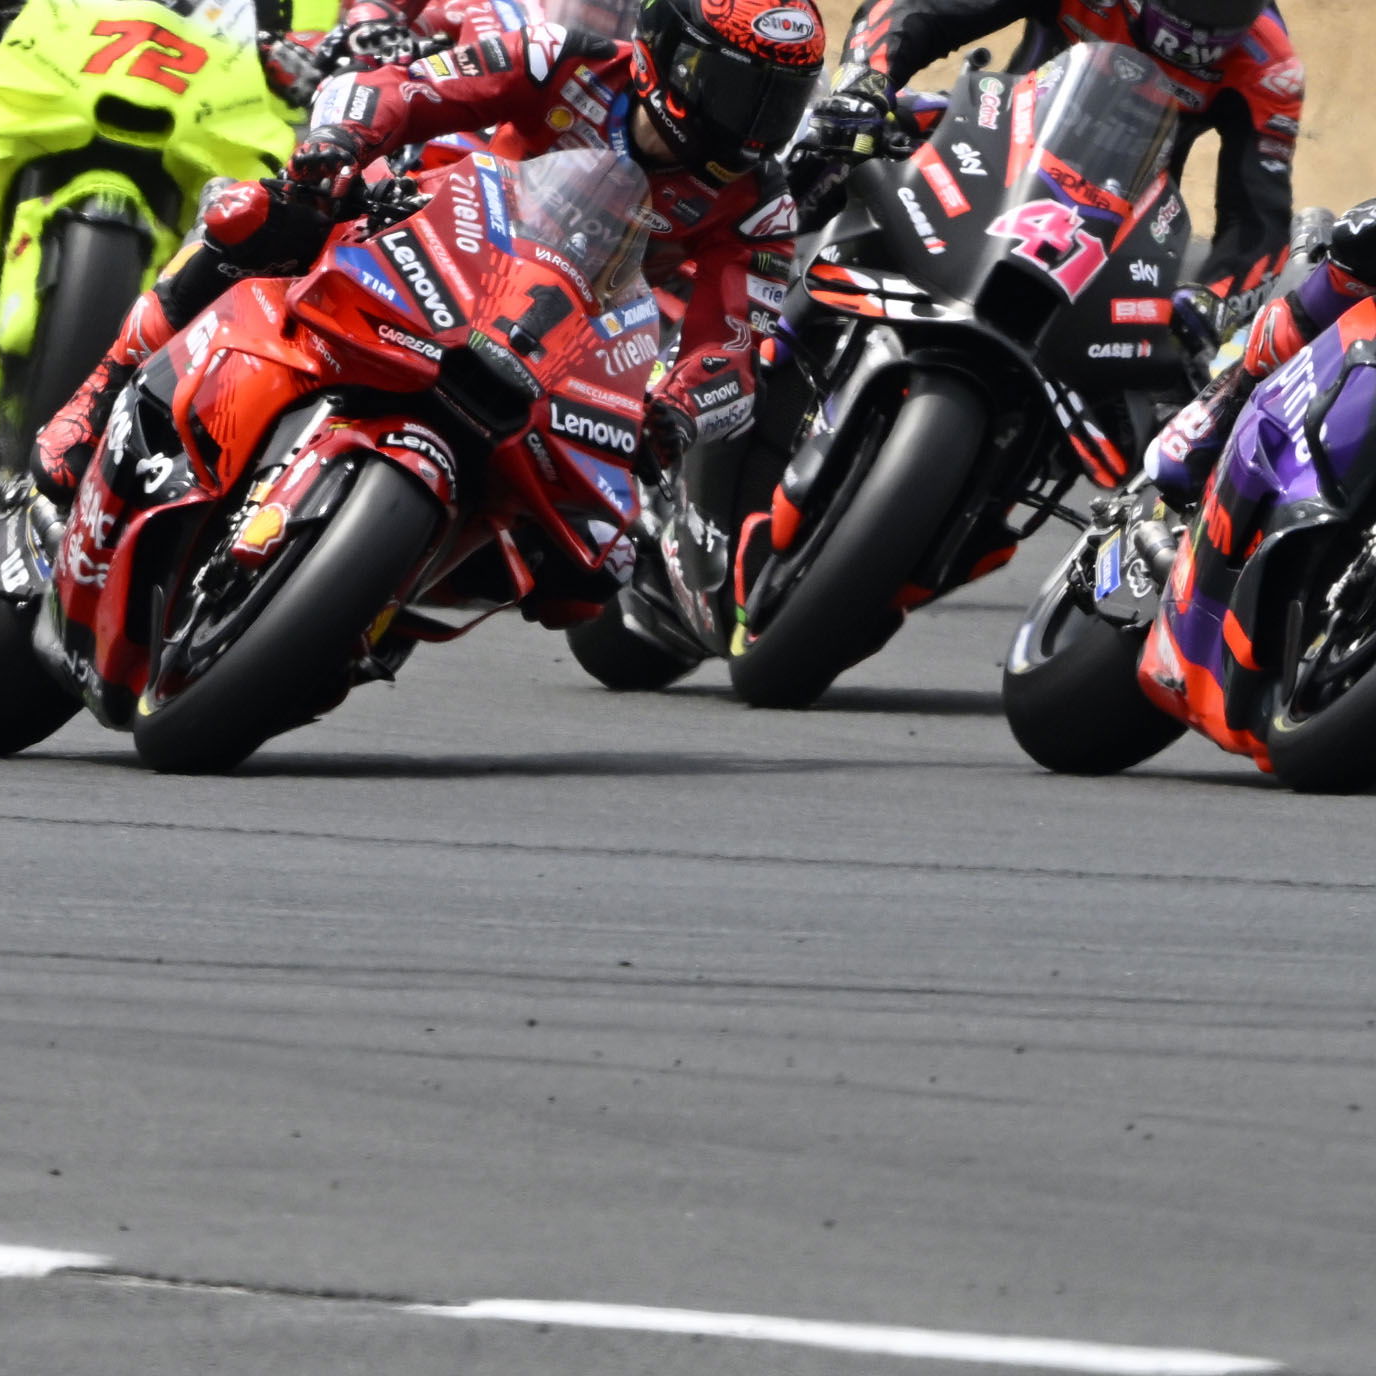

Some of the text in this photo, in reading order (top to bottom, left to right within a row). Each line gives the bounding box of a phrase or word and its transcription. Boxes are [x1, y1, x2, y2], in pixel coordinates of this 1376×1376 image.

[81, 19, 210, 96] 72
[649, 89, 687, 143] Lenovo
[984, 198, 1109, 304] 41
[1129, 259, 1159, 287] sky
[361, 269, 396, 302] TIM
[382, 230, 455, 329] Lenovo
[377, 324, 444, 363] CARRERA
[1087, 341, 1134, 359] CASE
[694, 378, 740, 409] Lenovo
[550, 402, 636, 454] Lenovo
